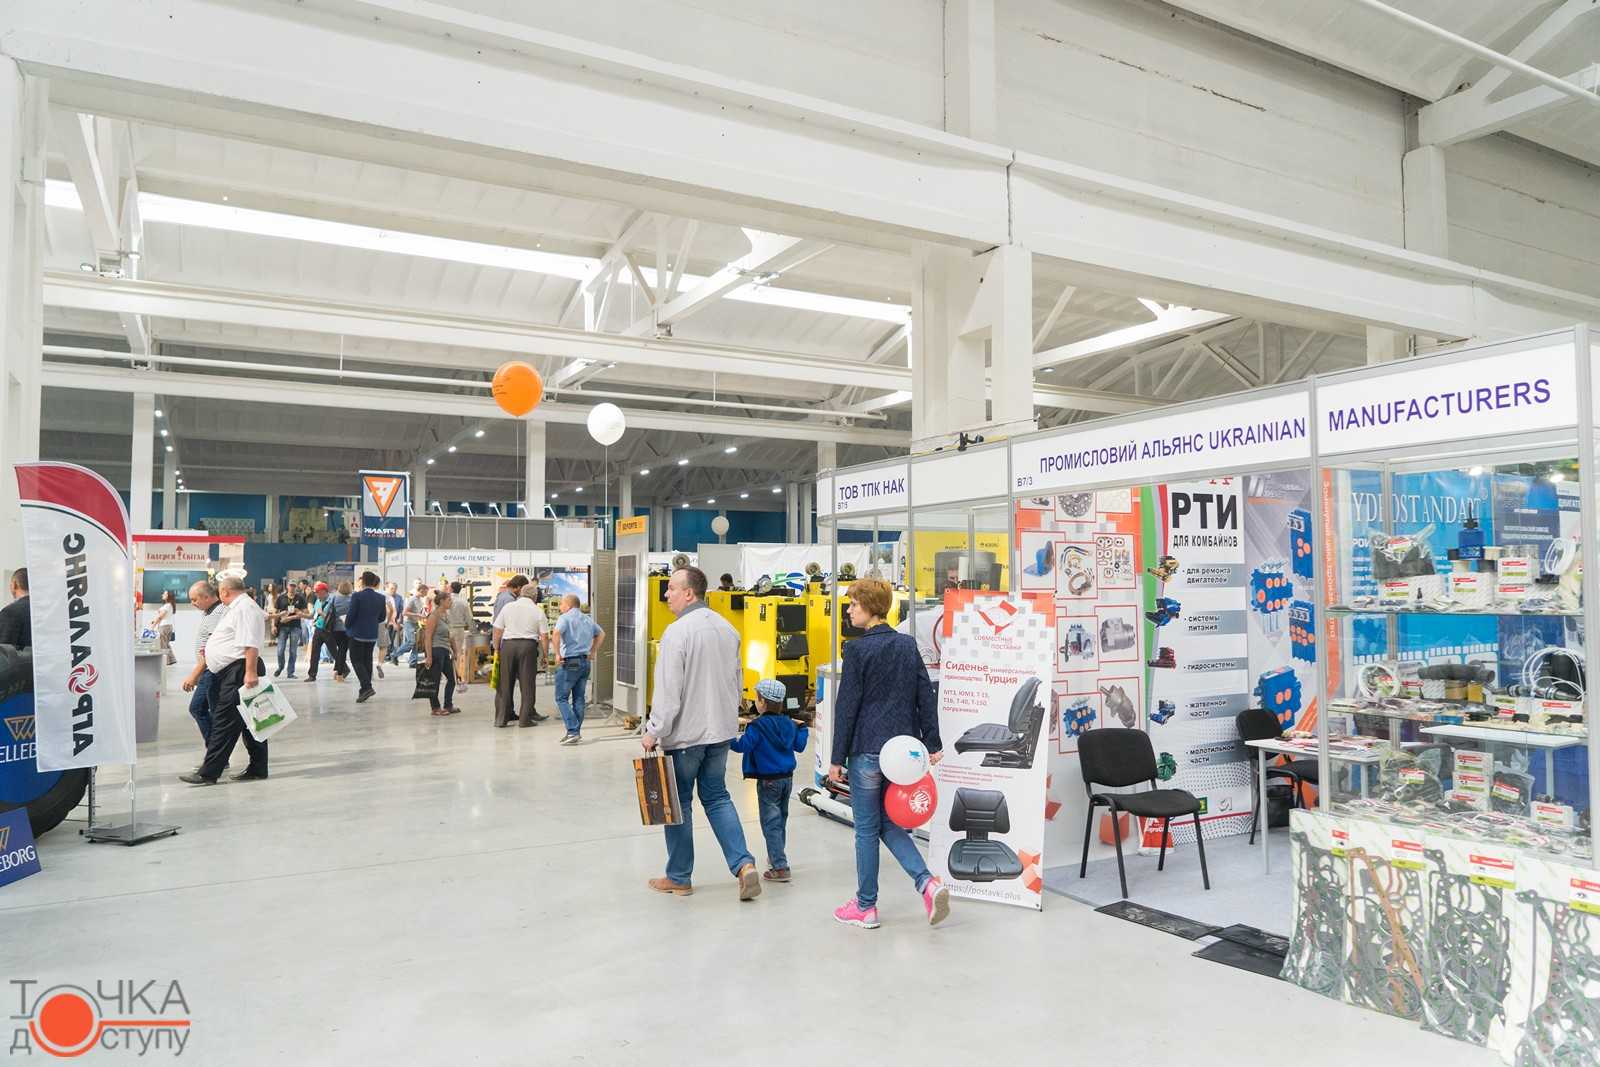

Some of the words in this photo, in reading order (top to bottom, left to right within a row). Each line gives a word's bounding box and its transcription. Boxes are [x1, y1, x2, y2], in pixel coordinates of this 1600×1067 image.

[1328, 378, 1551, 432] MANUFACTURERS
[1040, 440, 1137, 473] ПРОМИСЛОВИЙ
[1141, 433, 1203, 459] АЛЬЯНС
[1209, 417, 1306, 450] UKRAINIAN
[839, 485, 859, 500] ТОВ
[861, 481, 880, 497] ТПК
[883, 478, 905, 495] НАК
[1171, 492, 1238, 530] РТИ
[1173, 535, 1189, 548] ДЛЯ
[1191, 533, 1238, 548] КОМБАЙНОВ
[1201, 567, 1231, 575] ремонта
[945, 660, 989, 672] Сиденье
[1187, 662, 1235, 670] гидросистемы
[983, 673, 1018, 685] Турция
